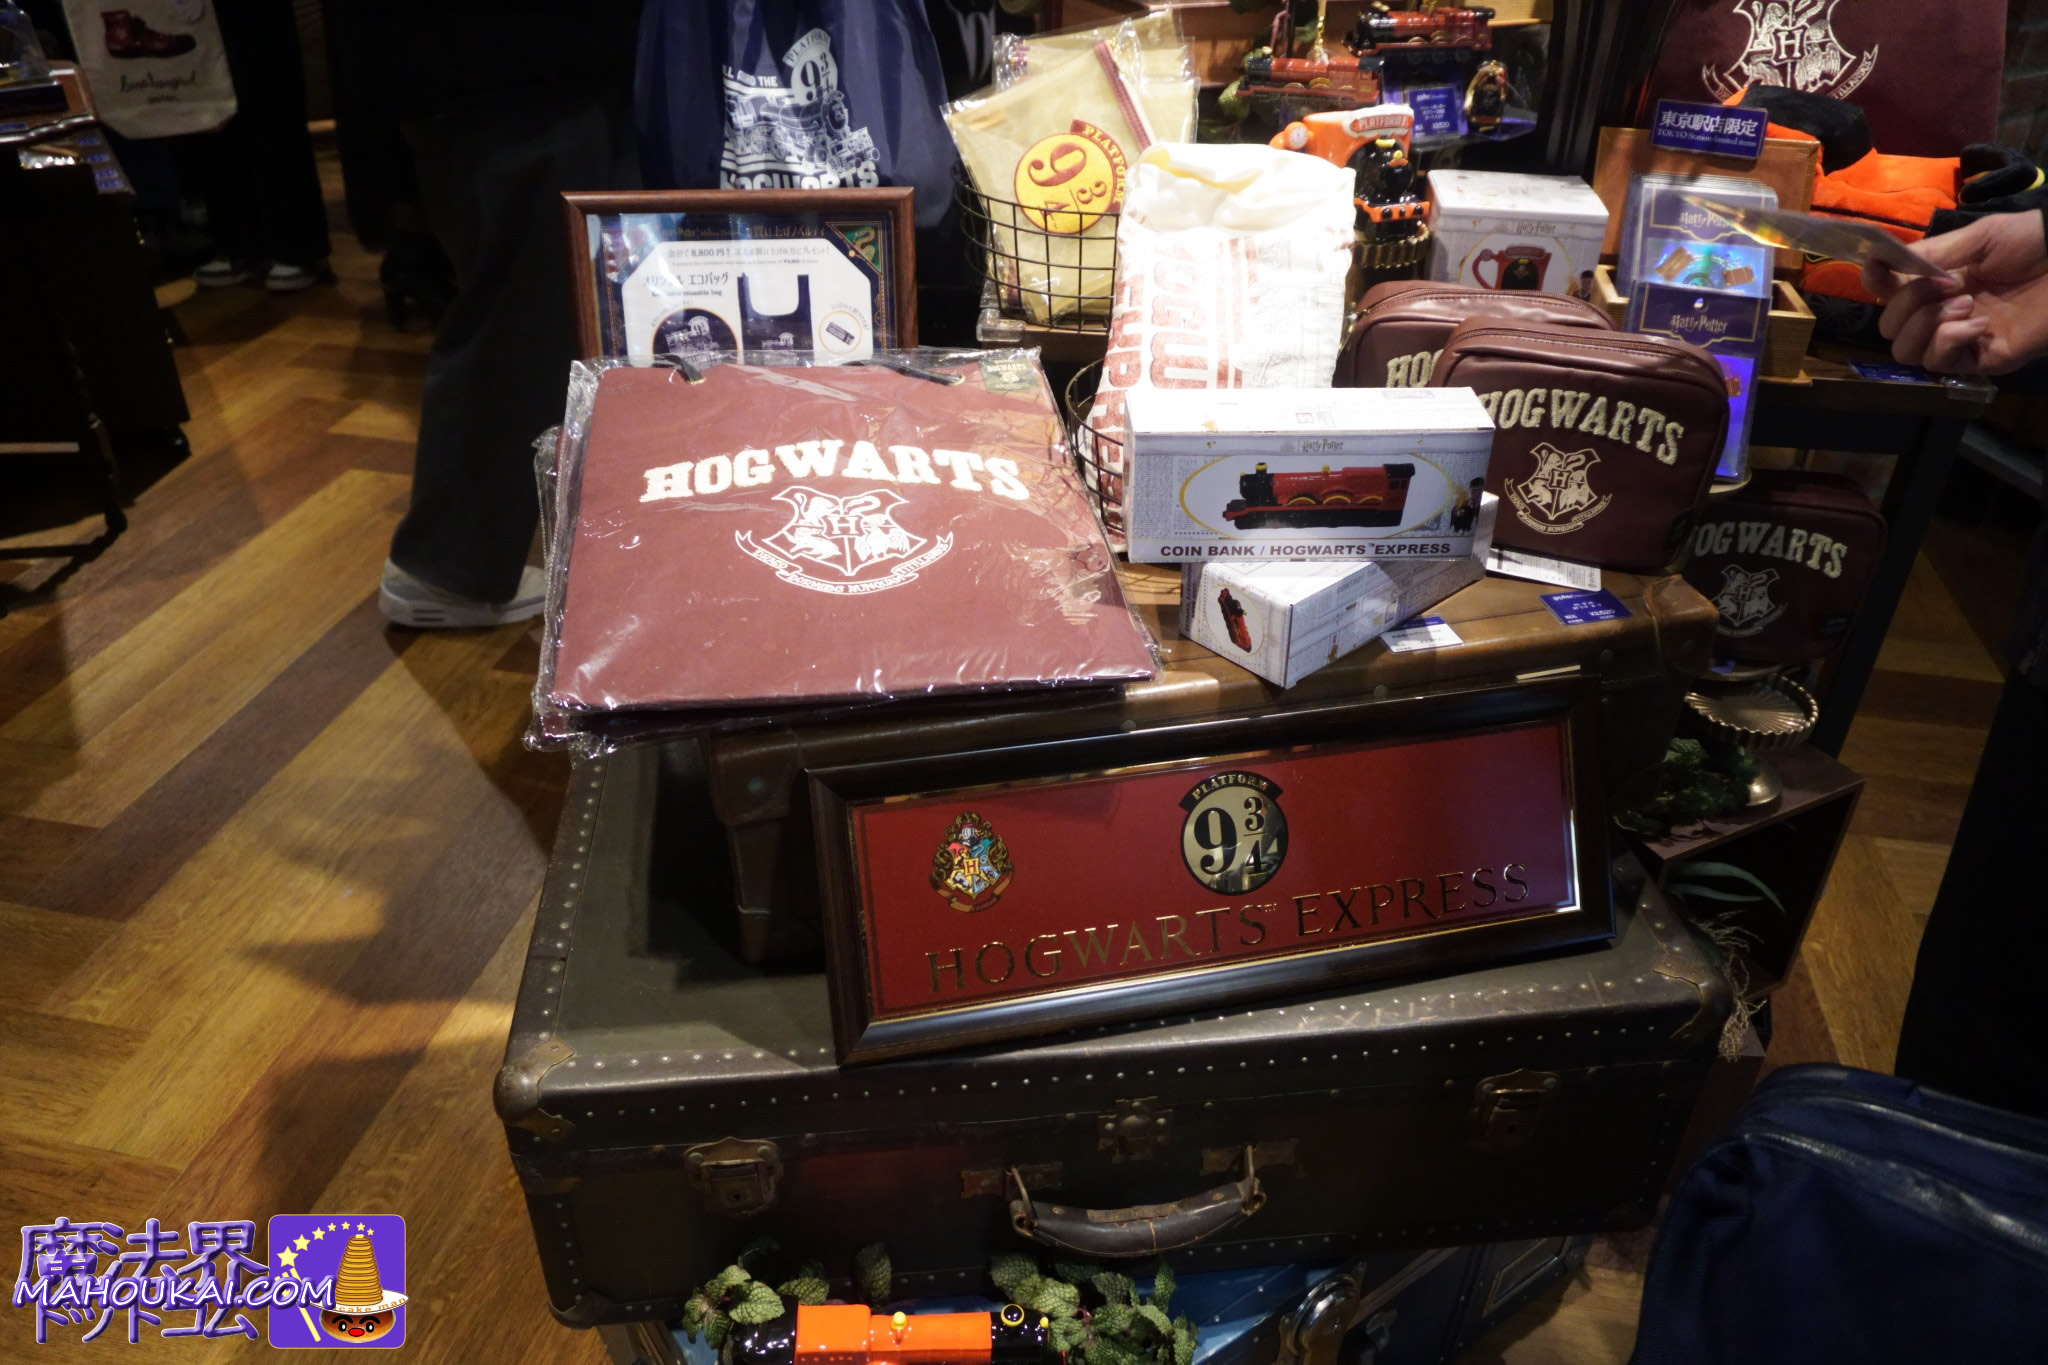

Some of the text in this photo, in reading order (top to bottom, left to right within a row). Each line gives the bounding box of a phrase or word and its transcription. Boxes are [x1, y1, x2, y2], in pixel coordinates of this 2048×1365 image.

[758, 75, 778, 87] THE
[1657, 127, 1688, 139] TOKYO
[1659, 109, 1758, 137] 東京駅店限定
[1670, 314, 1729, 334] Harry Potter
[1302, 438, 1344, 453] Harry Potter
[639, 439, 1031, 503] HOGWARTS
[1160, 545, 1202, 557] COIN
[1207, 545, 1255, 557] BANK
[1374, 543, 1451, 555] EXPRESS
[1693, 520, 1848, 579] OGWARTS
[1190, 772, 1270, 801] PLATFORM
[1291, 862, 1530, 938] EXPRESS
